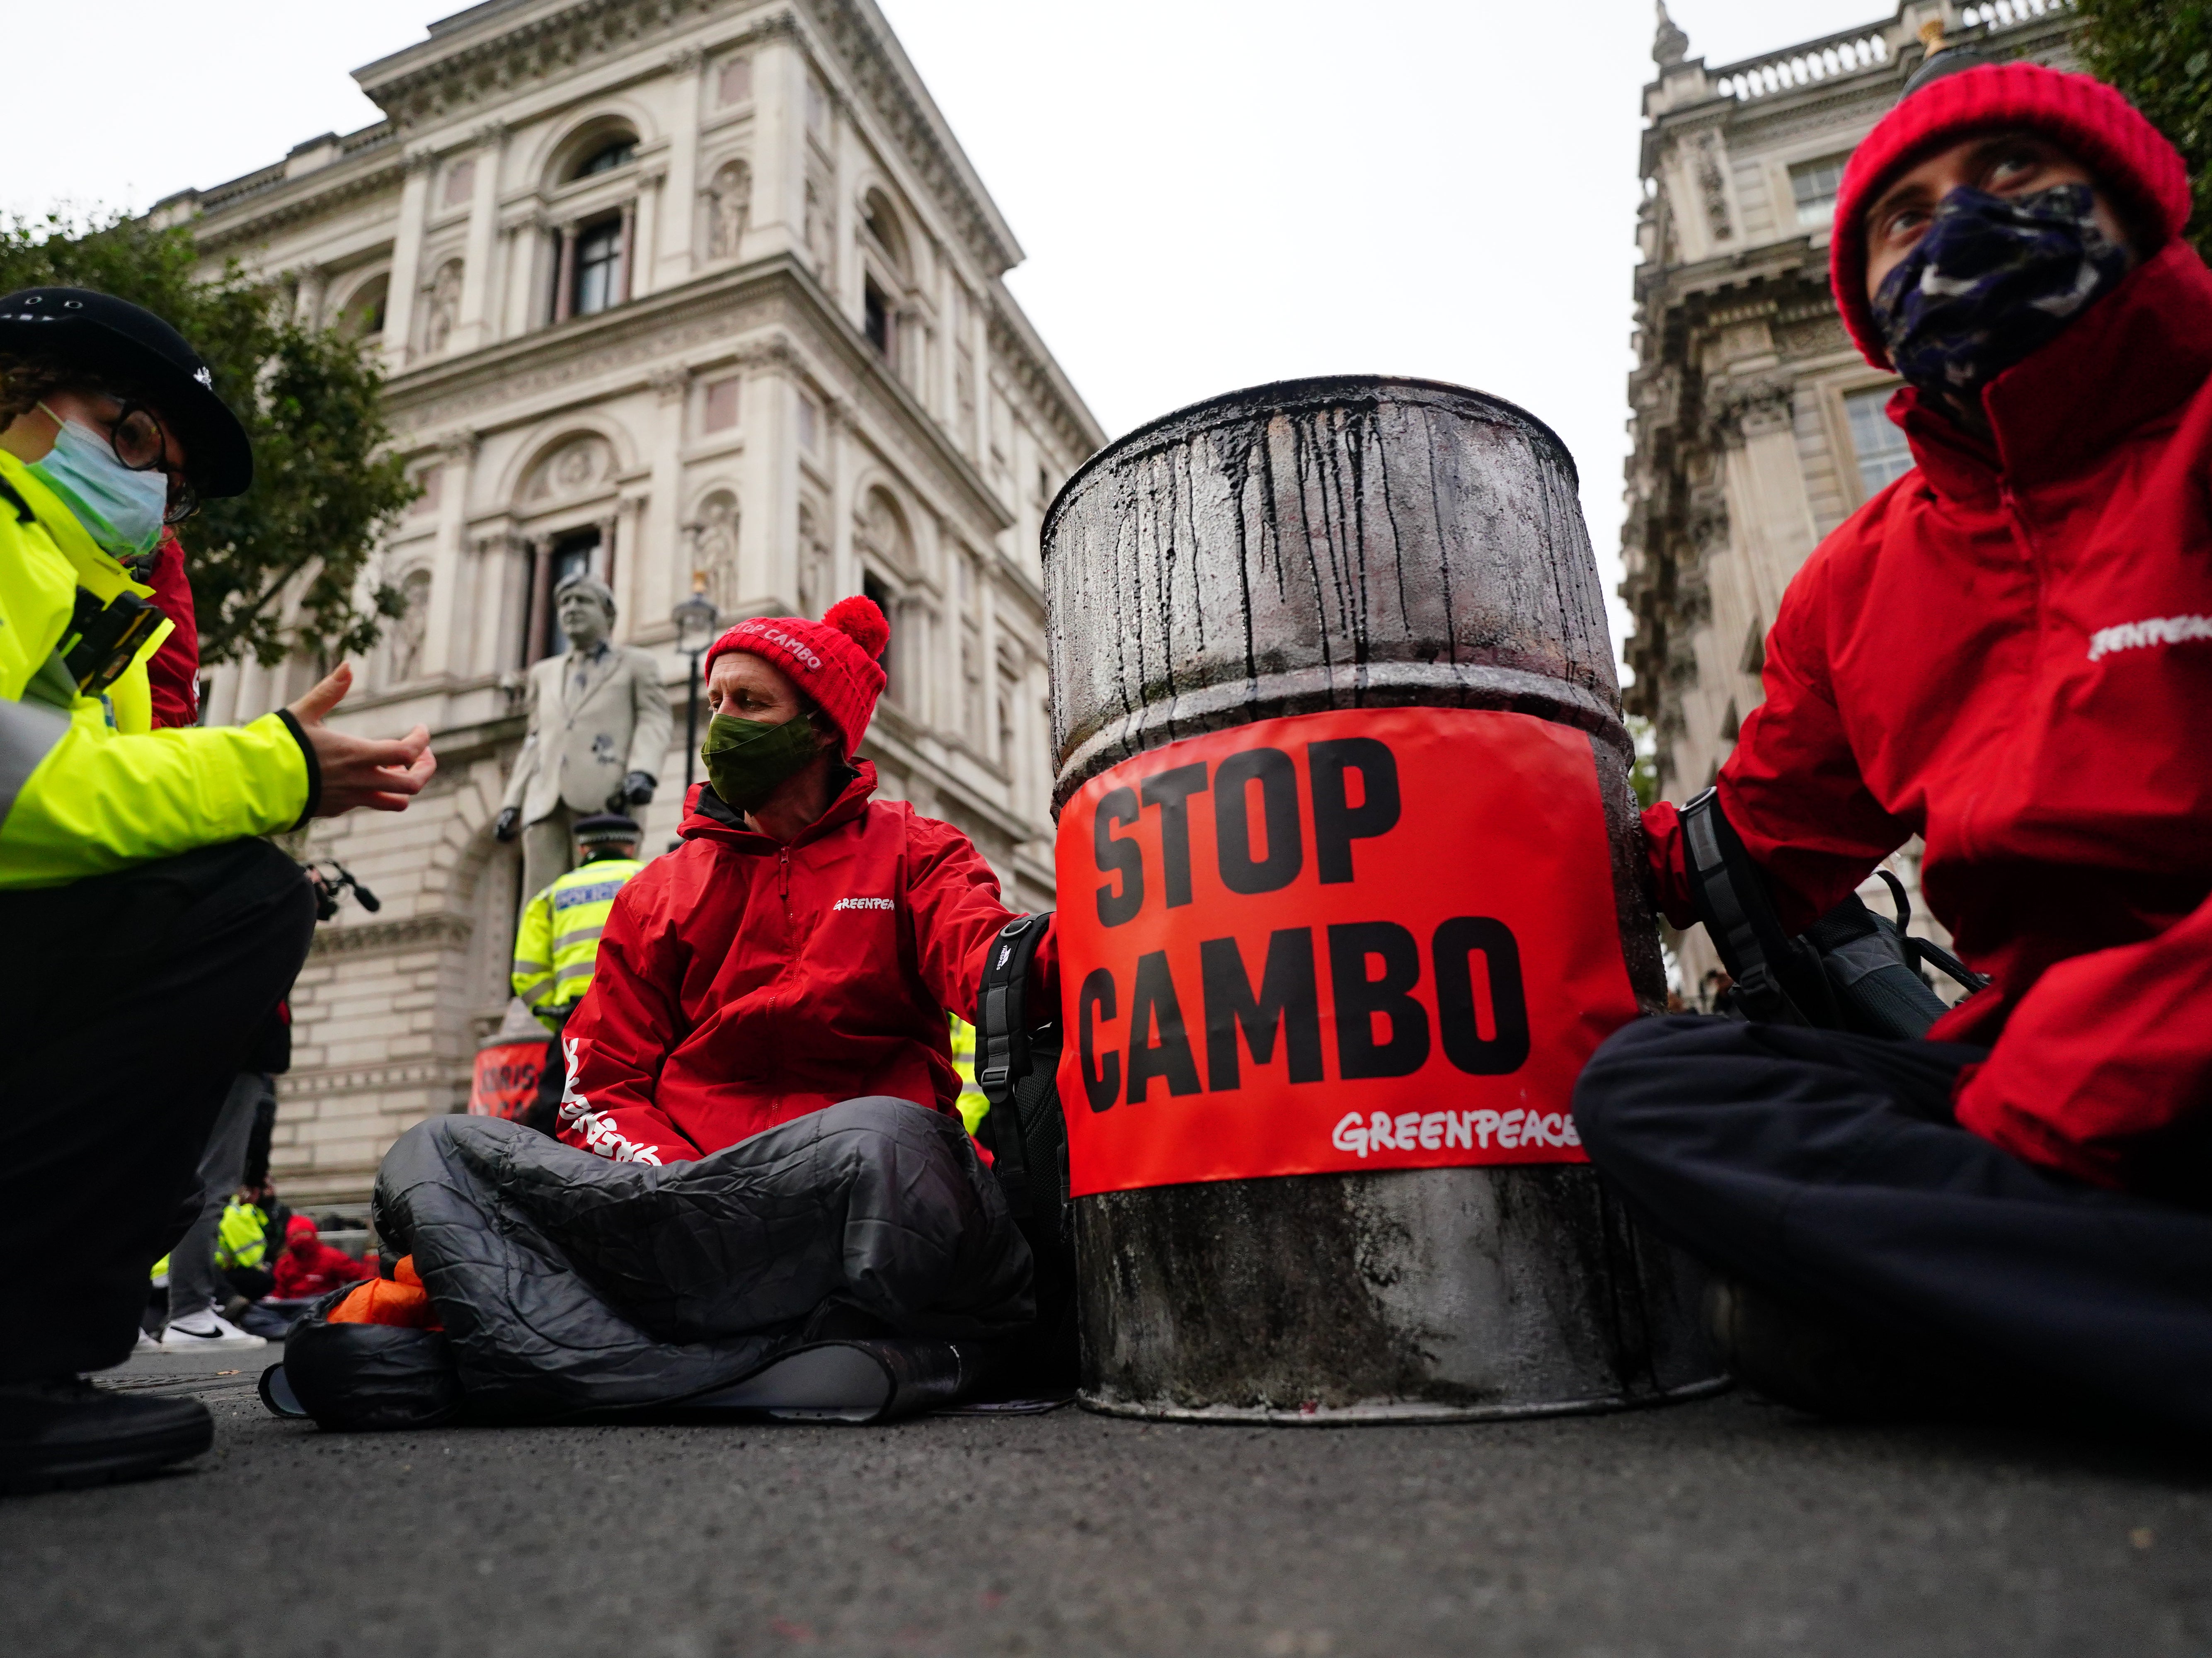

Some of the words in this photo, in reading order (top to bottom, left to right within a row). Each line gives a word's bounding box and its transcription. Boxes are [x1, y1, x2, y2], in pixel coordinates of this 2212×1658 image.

[726, 622, 766, 635] STOP
[764, 629, 821, 669] CAMBO
[1094, 737, 1402, 928] STOP
[833, 898, 895, 911] GREENPEA
[996, 945, 1008, 970] TRESPASS
[1078, 916, 1531, 1113] CAMBO
[1332, 1108, 1582, 1158] GREENPEACE
